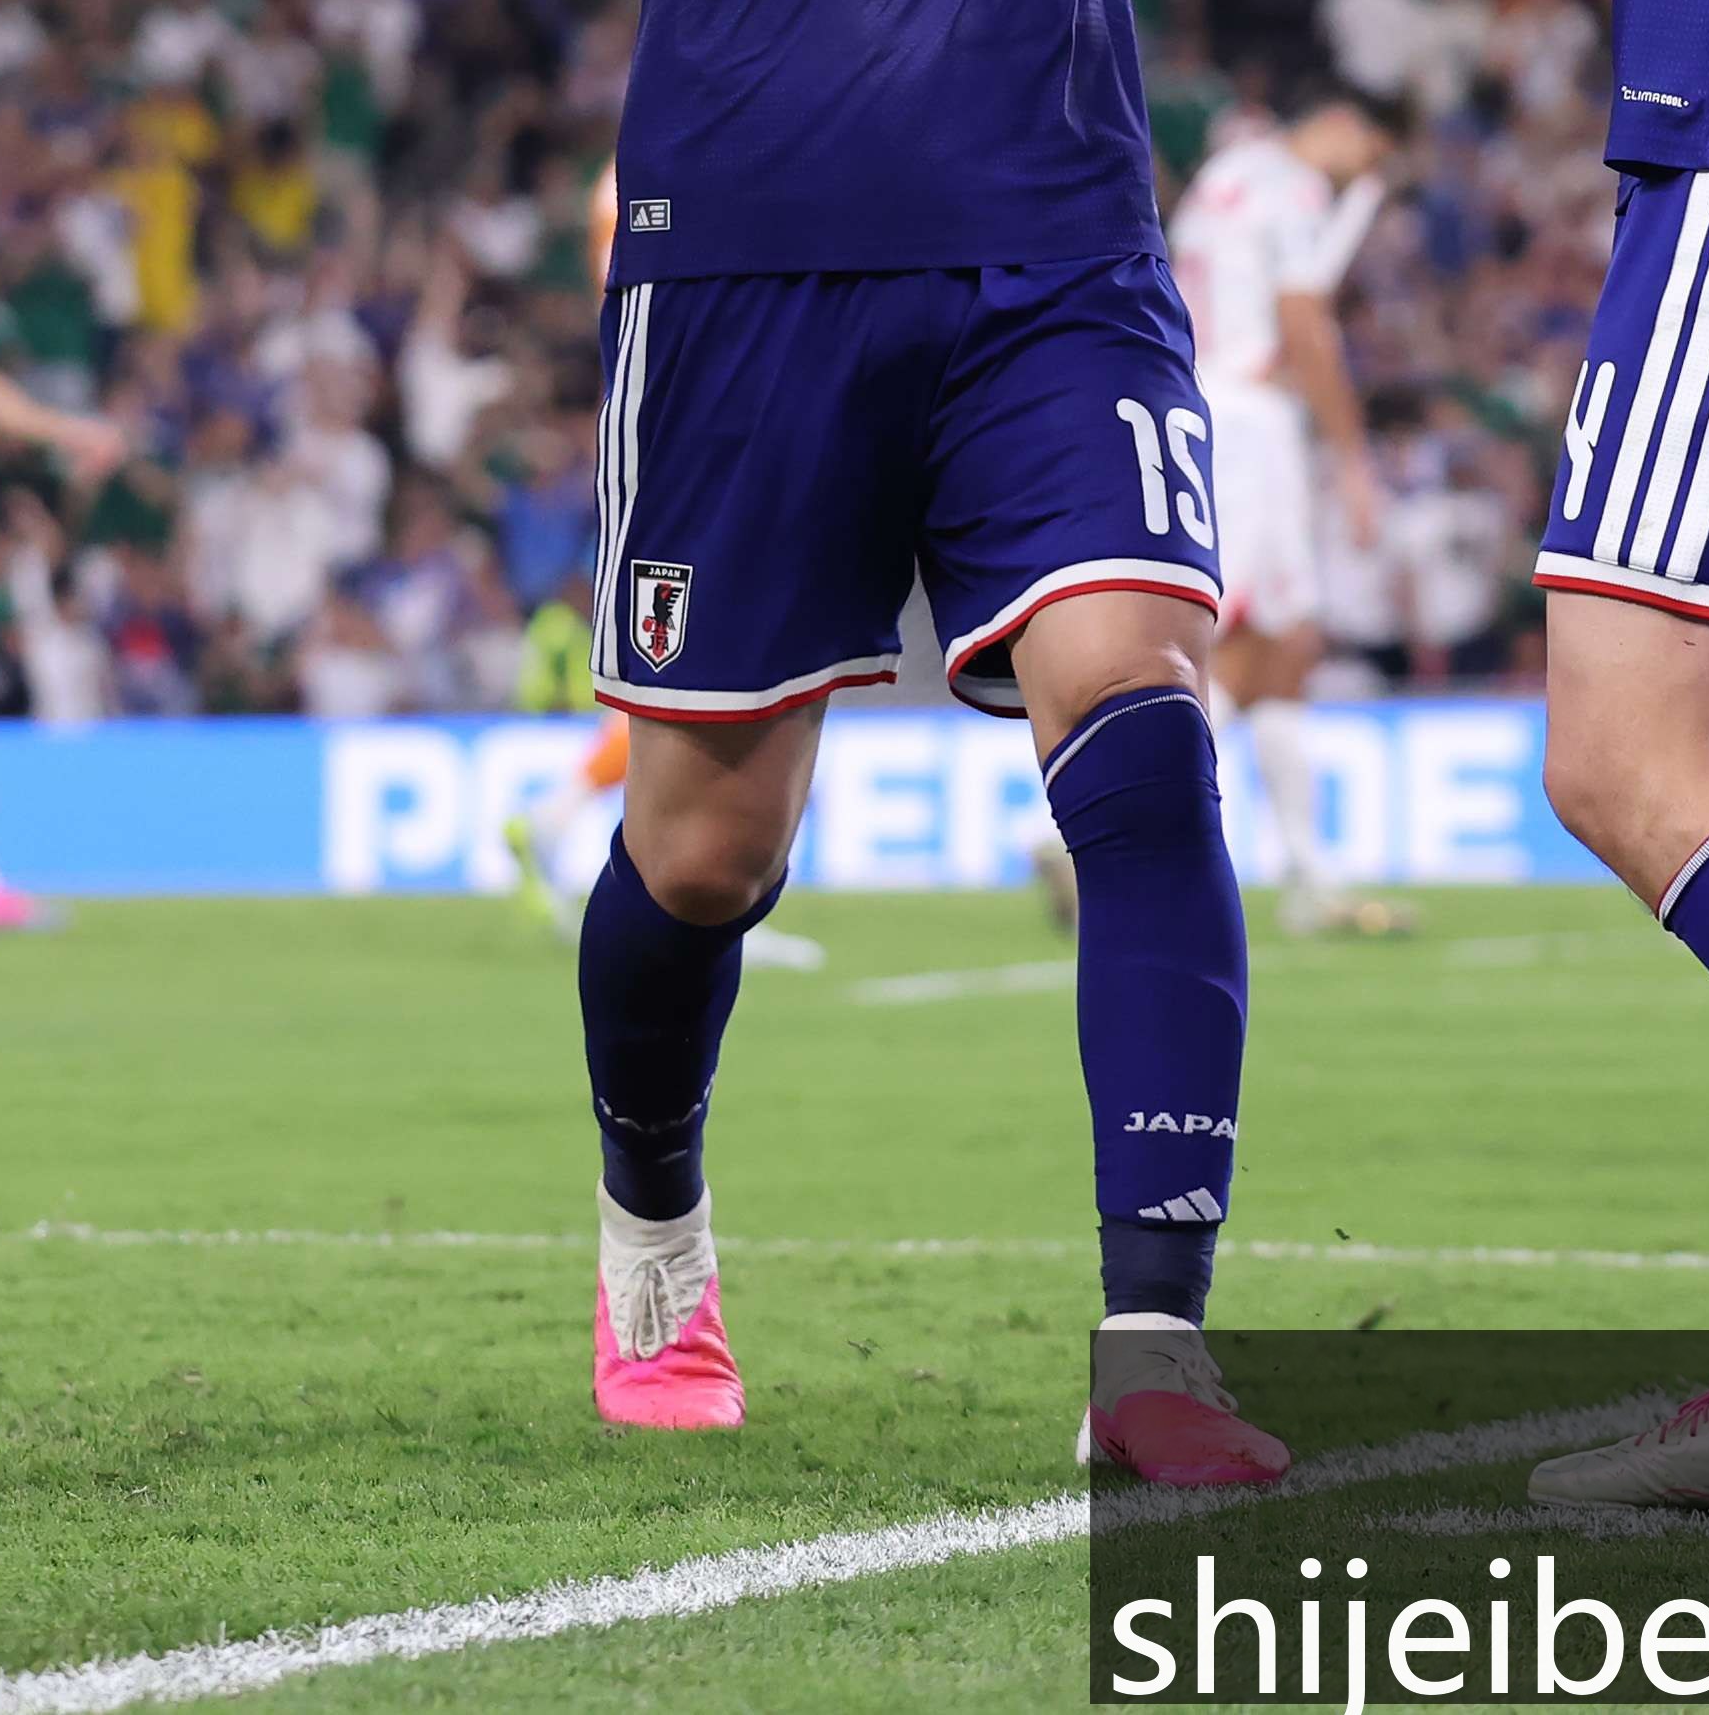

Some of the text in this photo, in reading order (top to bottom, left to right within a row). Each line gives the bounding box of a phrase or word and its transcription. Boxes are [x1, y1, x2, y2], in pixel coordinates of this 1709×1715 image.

[1116, 397, 1214, 550] 15
[648, 567, 681, 579] JAPAN
[1123, 1111, 1238, 1141] JAPA
